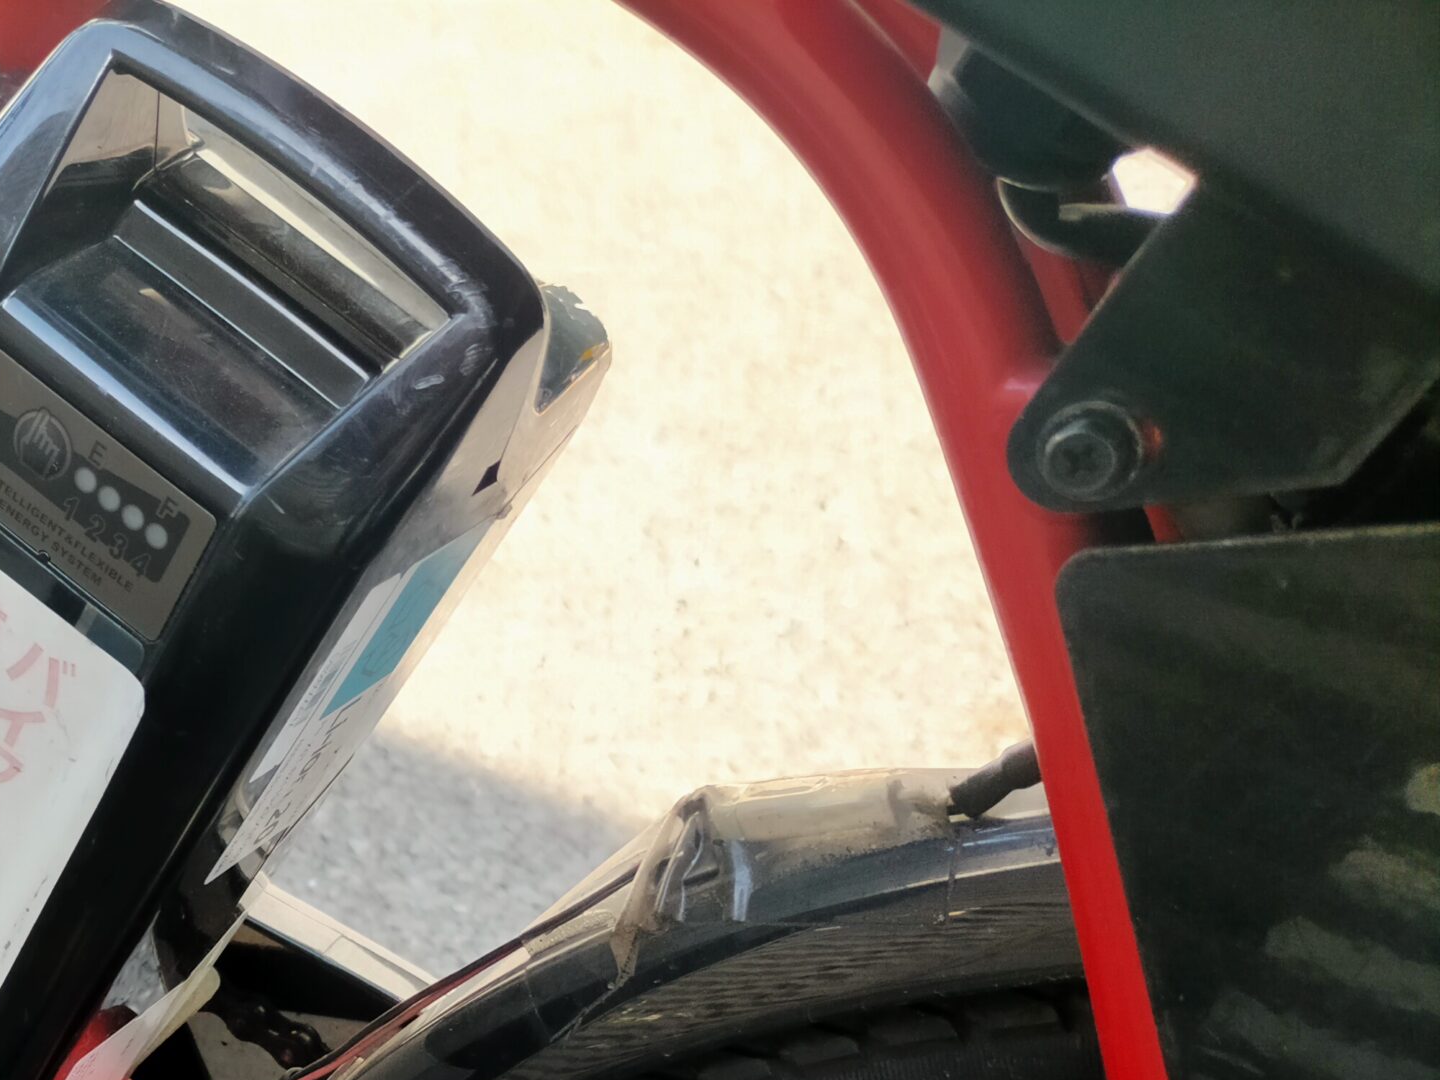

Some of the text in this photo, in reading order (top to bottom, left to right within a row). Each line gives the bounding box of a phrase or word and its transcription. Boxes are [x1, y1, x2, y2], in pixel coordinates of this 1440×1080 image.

[86, 438, 108, 468] E
[155, 495, 180, 520] F
[62, 496, 152, 578] 1 2 3 4
[51, 541, 103, 588] SYSTEM
